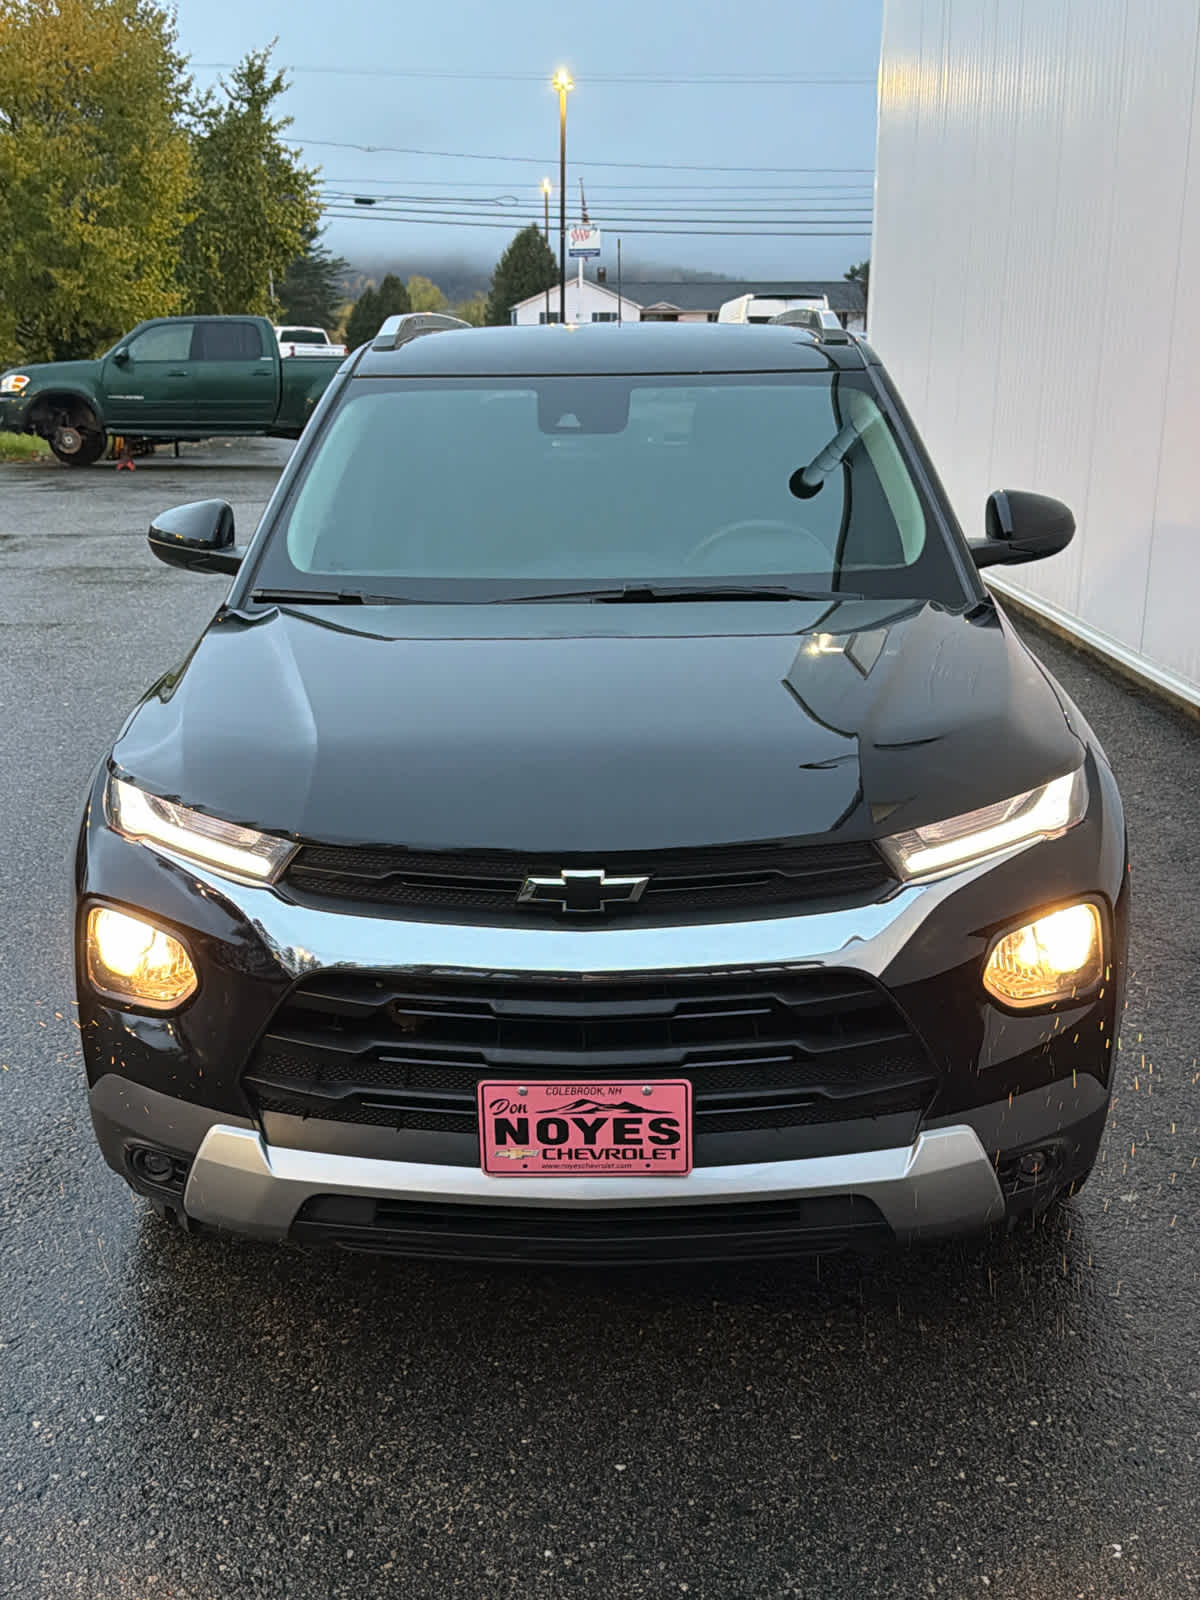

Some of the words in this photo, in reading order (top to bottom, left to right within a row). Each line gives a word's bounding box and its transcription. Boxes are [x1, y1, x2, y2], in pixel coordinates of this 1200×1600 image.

[545, 1087, 605, 1096] COLEBROOK,
[607, 1087, 622, 1095] NH
[489, 1098, 528, 1115] Don
[494, 1117, 681, 1145] NOYES
[542, 1148, 681, 1160] CHEVROLET
